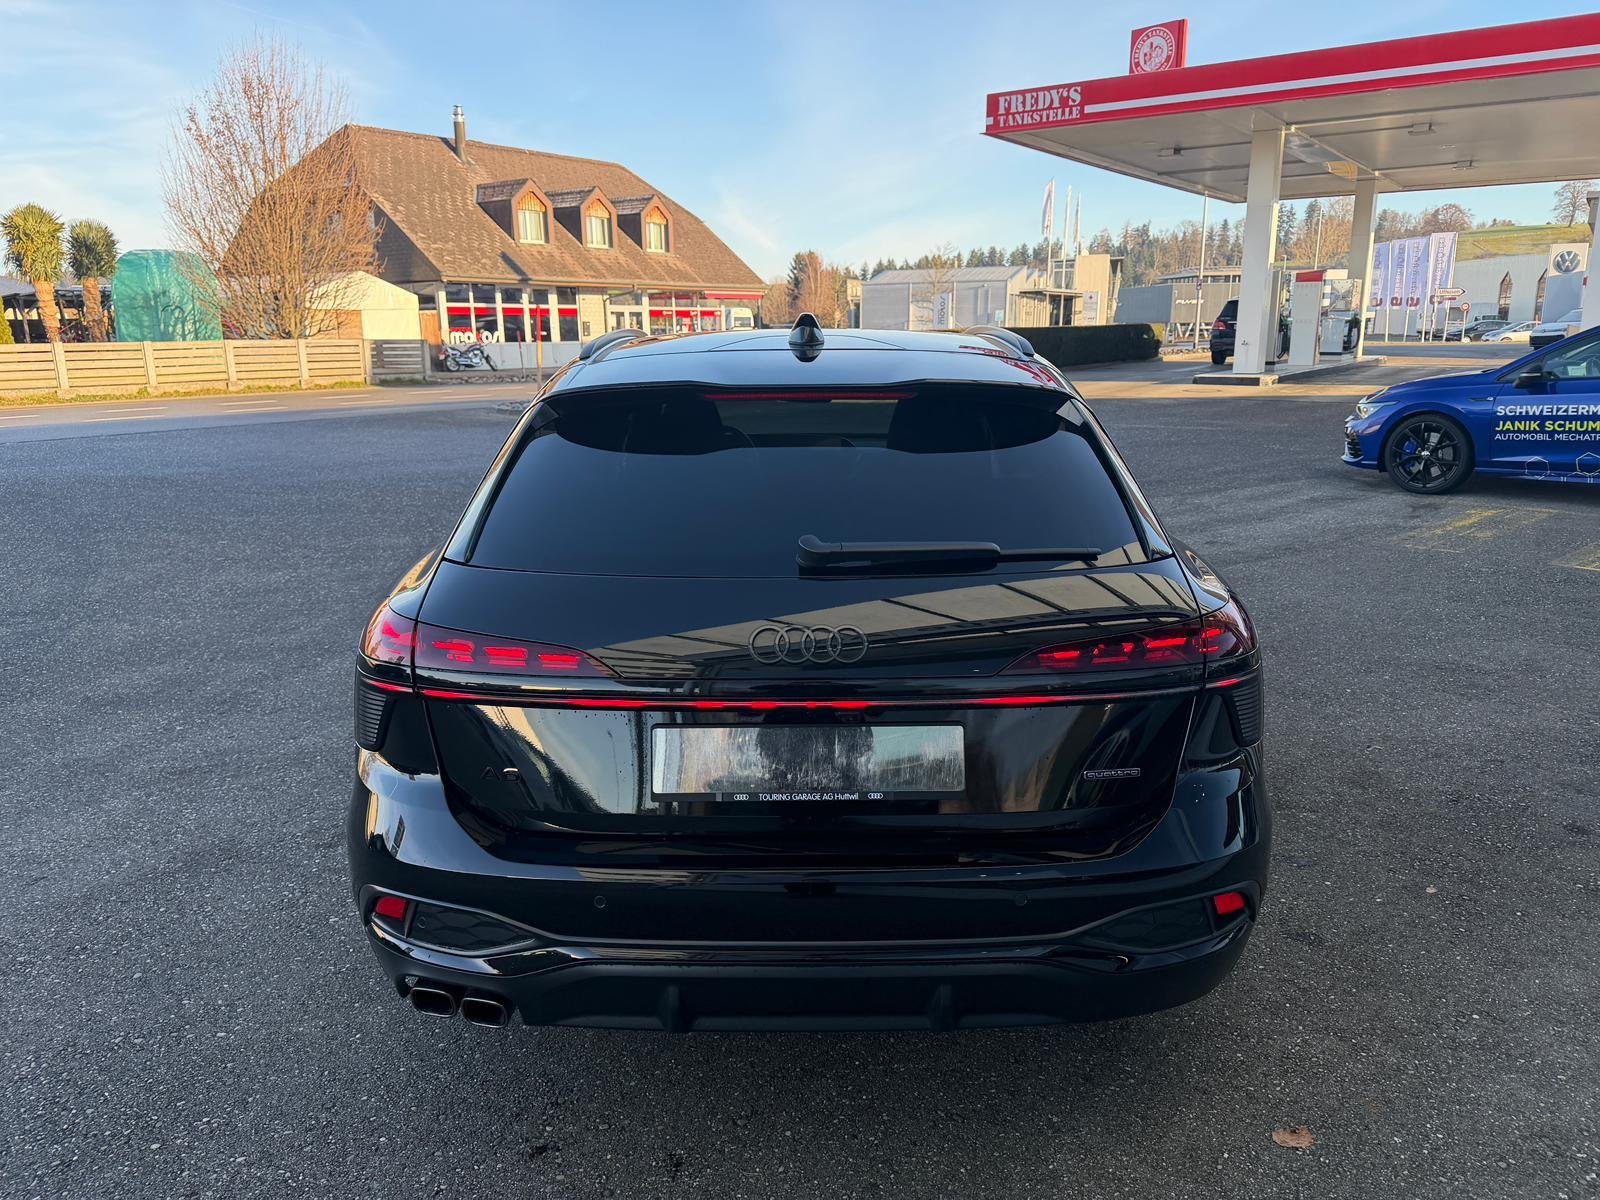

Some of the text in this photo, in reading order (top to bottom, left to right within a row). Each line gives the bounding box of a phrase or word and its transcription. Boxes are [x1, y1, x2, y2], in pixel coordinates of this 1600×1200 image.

[997, 106, 1081, 127] TANKSTELLE
[1496, 405, 1600, 416] SCHWEIZERM
[1495, 420, 1600, 431] JANIK SCHUM
[1494, 433, 1551, 441] AUTOMOBIL
[1086, 770, 1138, 779] quattro
[758, 793, 791, 801] TOURING
[834, 792, 859, 800] Huttwil
